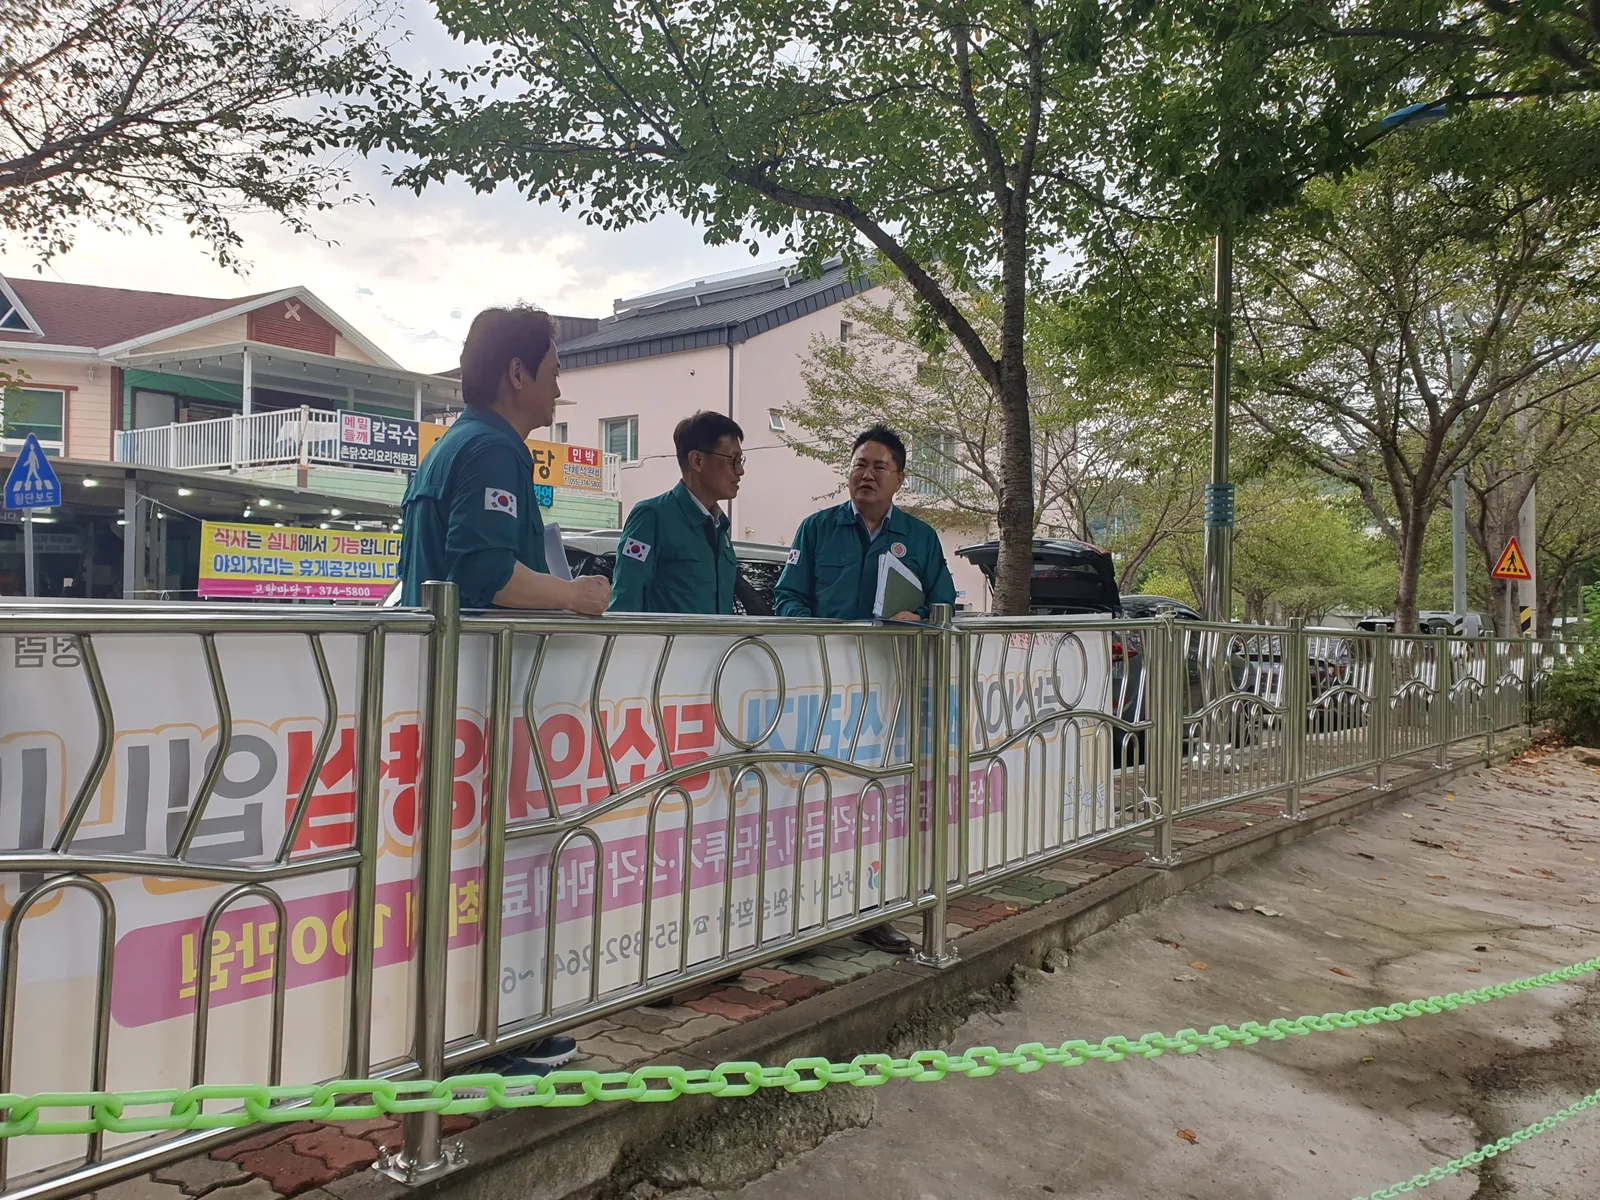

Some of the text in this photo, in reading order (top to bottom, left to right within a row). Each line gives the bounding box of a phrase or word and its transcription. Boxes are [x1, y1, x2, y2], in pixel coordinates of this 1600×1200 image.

[344, 415, 368, 431] 메밀
[344, 429, 368, 443] 들깨
[372, 421, 418, 447] 칼국수
[572, 448, 595, 465] 민박
[15, 492, 55, 505] 횡단보도
[213, 528, 401, 556] 식사는 실내에서 가능합니다
[213, 554, 401, 579] 야외자리는 휴게공간입니다
[252, 583, 301, 598] 고향마당
[319, 588, 371, 597] 374-5800
